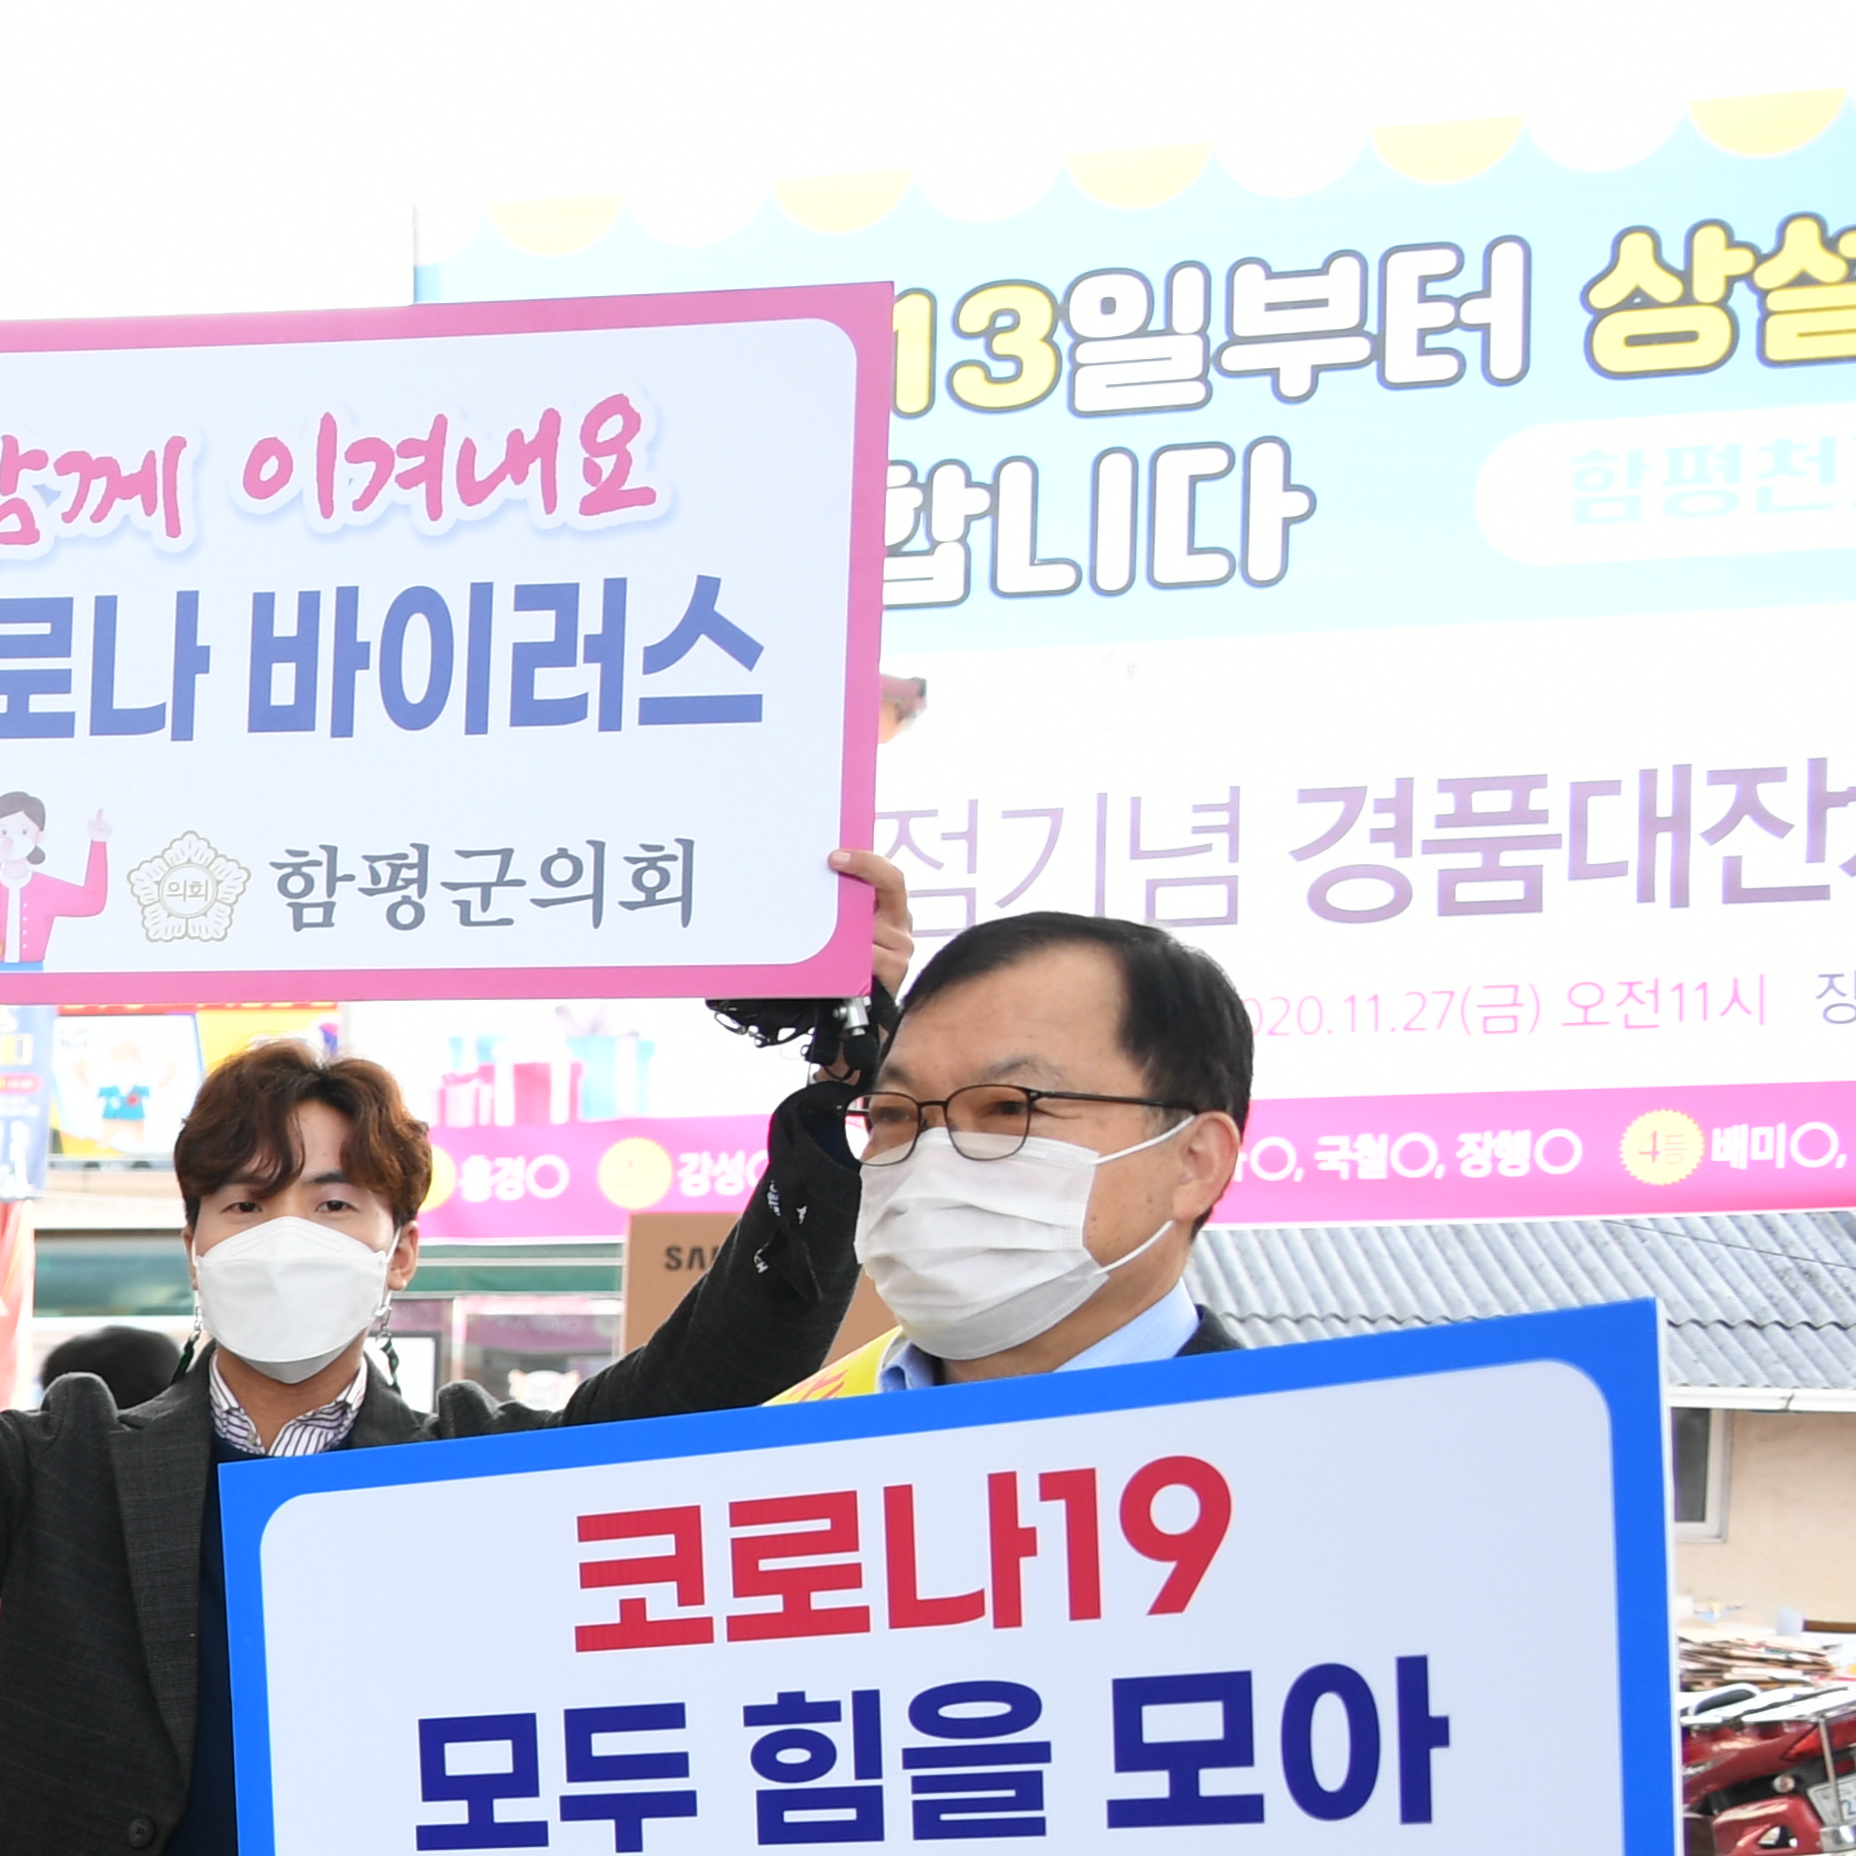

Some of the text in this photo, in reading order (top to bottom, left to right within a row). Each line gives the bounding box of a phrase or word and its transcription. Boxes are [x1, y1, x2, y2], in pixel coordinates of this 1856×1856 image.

[243, 393, 657, 522] 이겨내요
[1568, 435, 1856, 527] 함평천
[246, 572, 767, 740] 바이러스
[164, 872, 211, 906] 의회
[268, 836, 696, 934] 함평군의회
[1252, 982, 1541, 1038] 020.11.27(금)
[573, 1454, 1234, 1654] 코로나19
[415, 1654, 1451, 1854] 모두 힘을 모아
